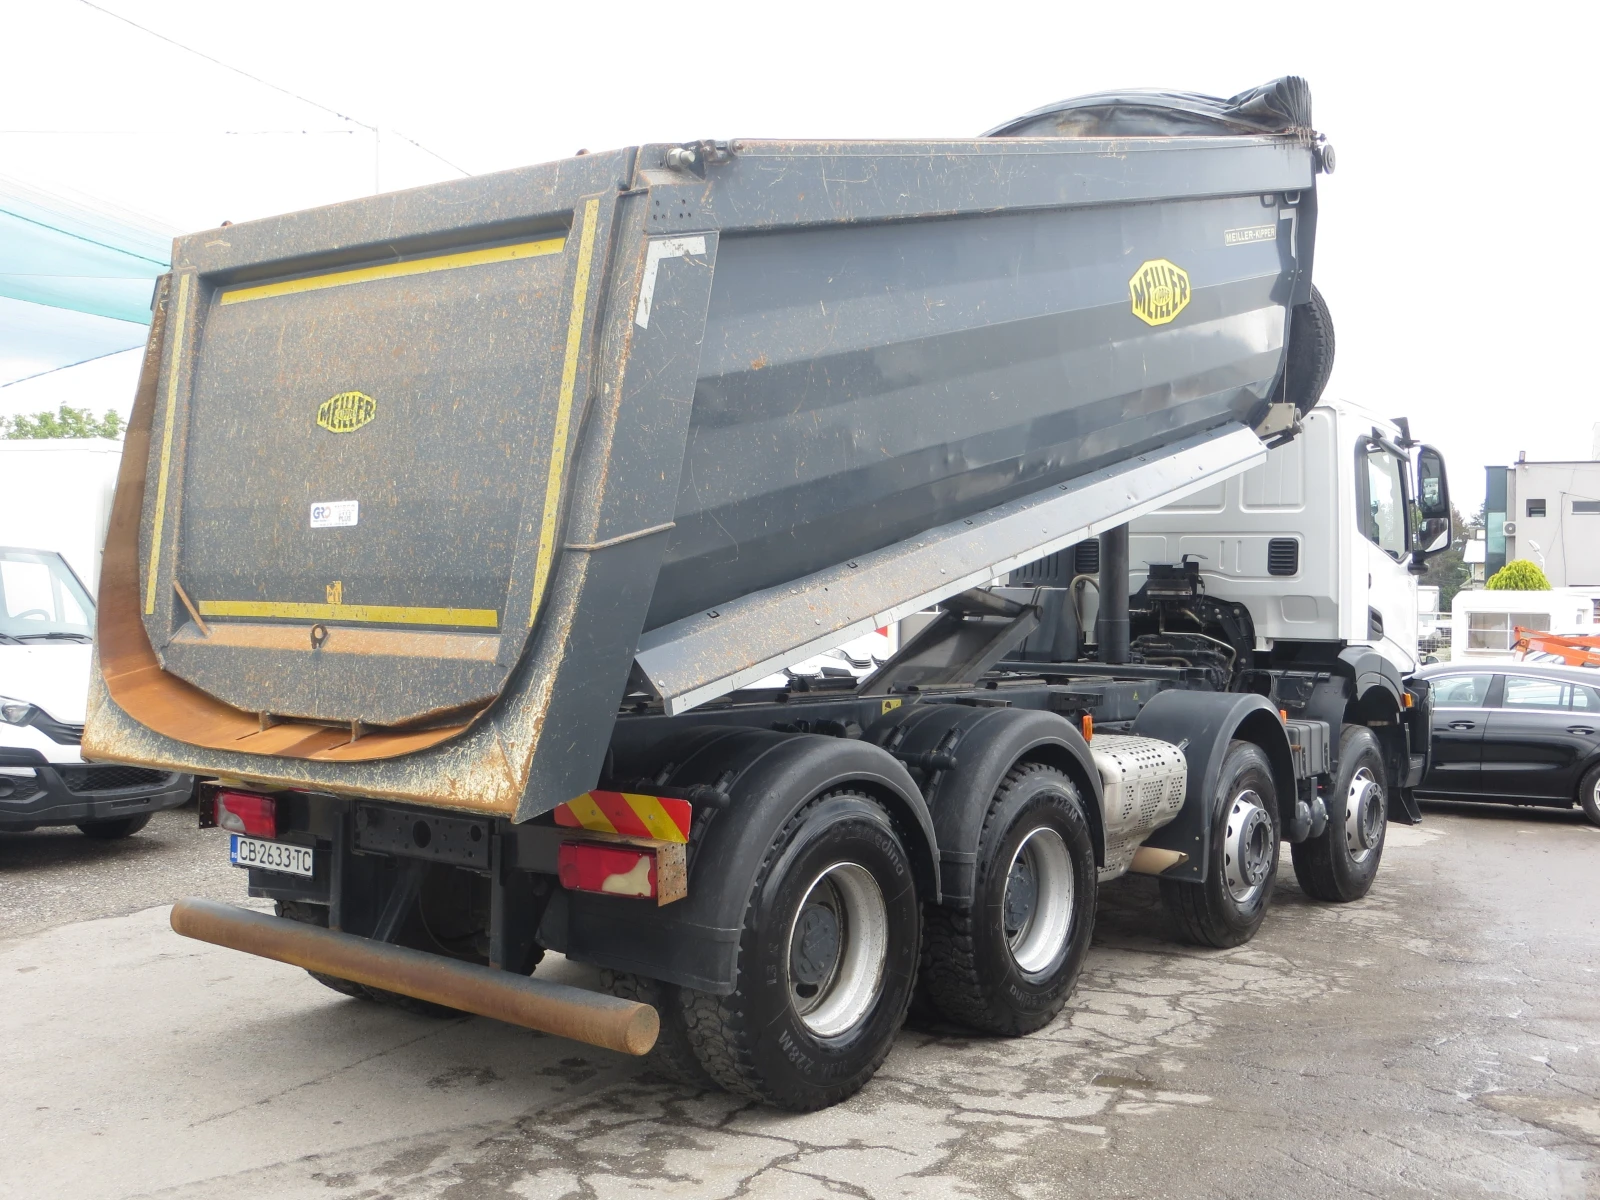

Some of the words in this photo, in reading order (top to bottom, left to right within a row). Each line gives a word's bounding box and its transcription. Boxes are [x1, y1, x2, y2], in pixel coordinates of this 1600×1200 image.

[1226, 228, 1275, 243] MEILLER-KIPPER
[1133, 265, 1188, 320] MEILLER
[319, 395, 374, 429] MEILLER
